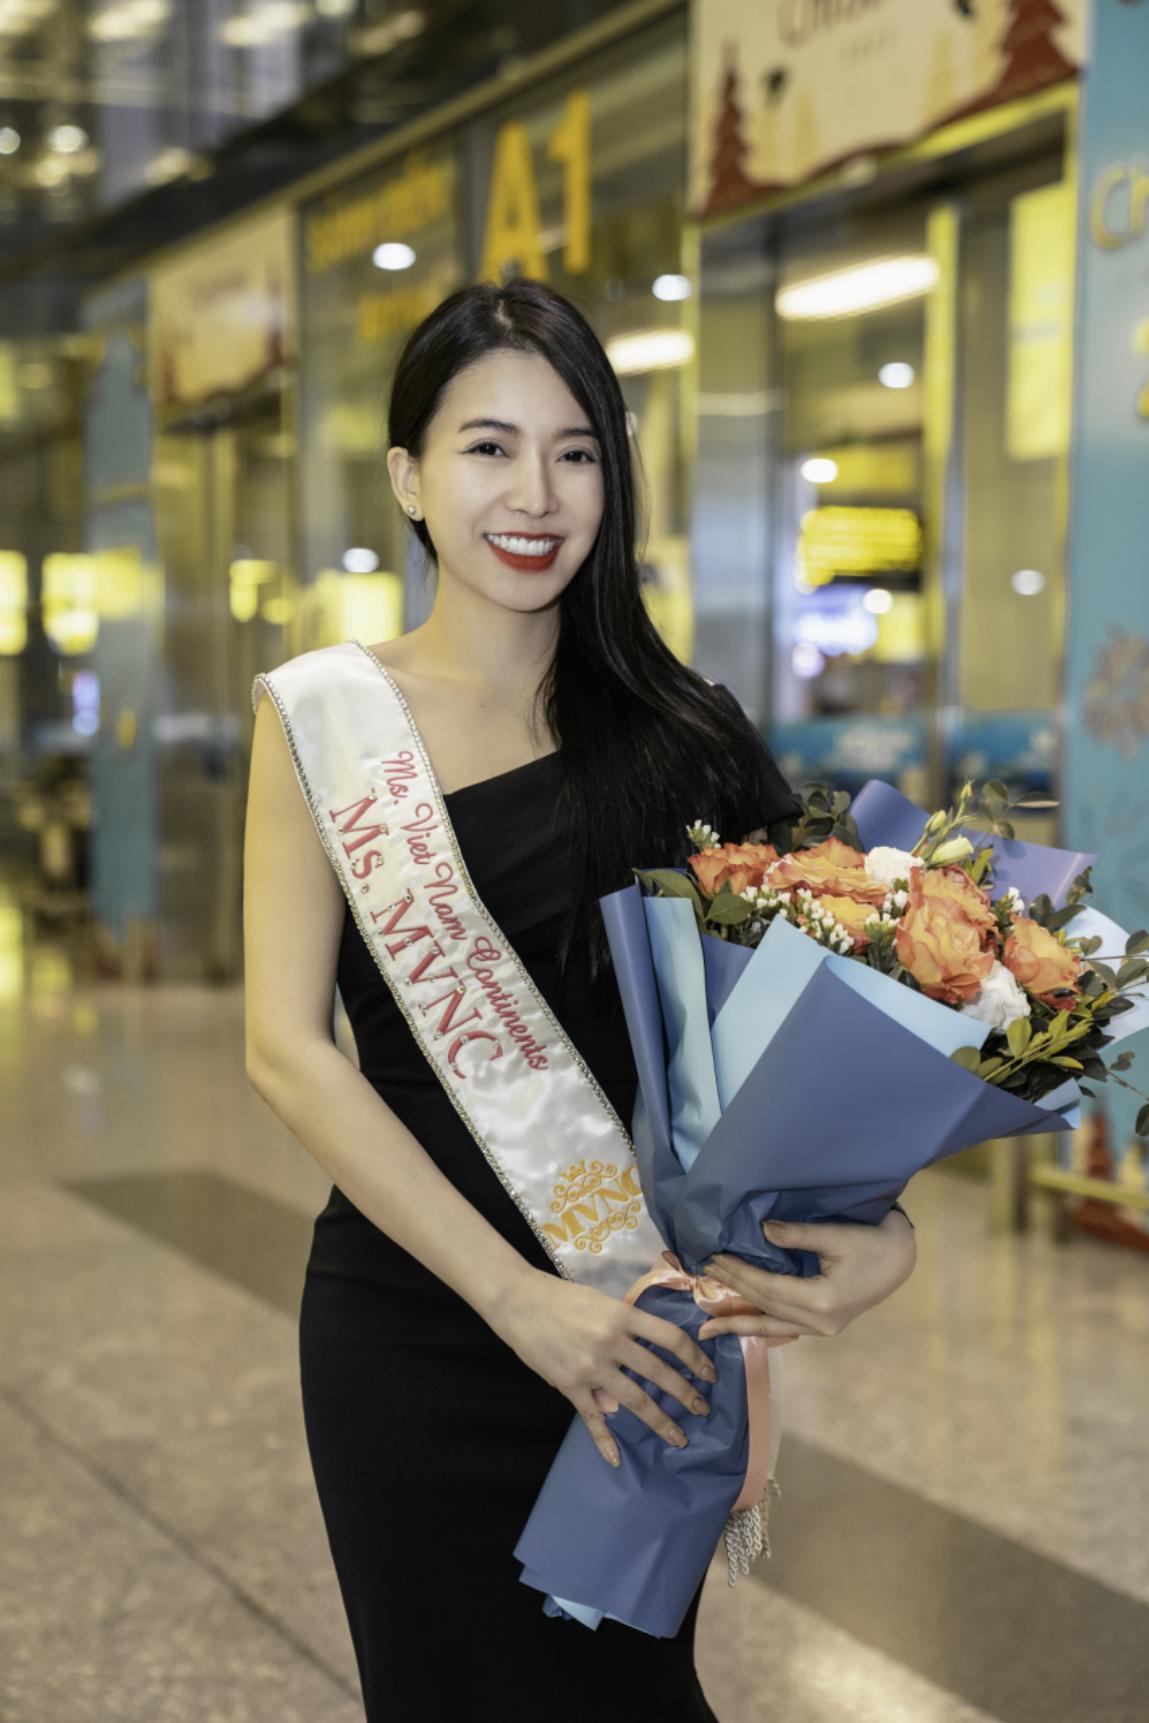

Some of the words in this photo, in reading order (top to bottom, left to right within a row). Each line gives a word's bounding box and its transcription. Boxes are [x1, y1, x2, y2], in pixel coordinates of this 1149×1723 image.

[477, 88, 590, 283] A1
[329, 788, 389, 894] Ms.
[369, 888, 504, 1079] MVNC
[381, 750, 418, 806] Ms.
[400, 803, 438, 865] Viet
[423, 862, 469, 941] Nam
[466, 936, 549, 1071] Continents
